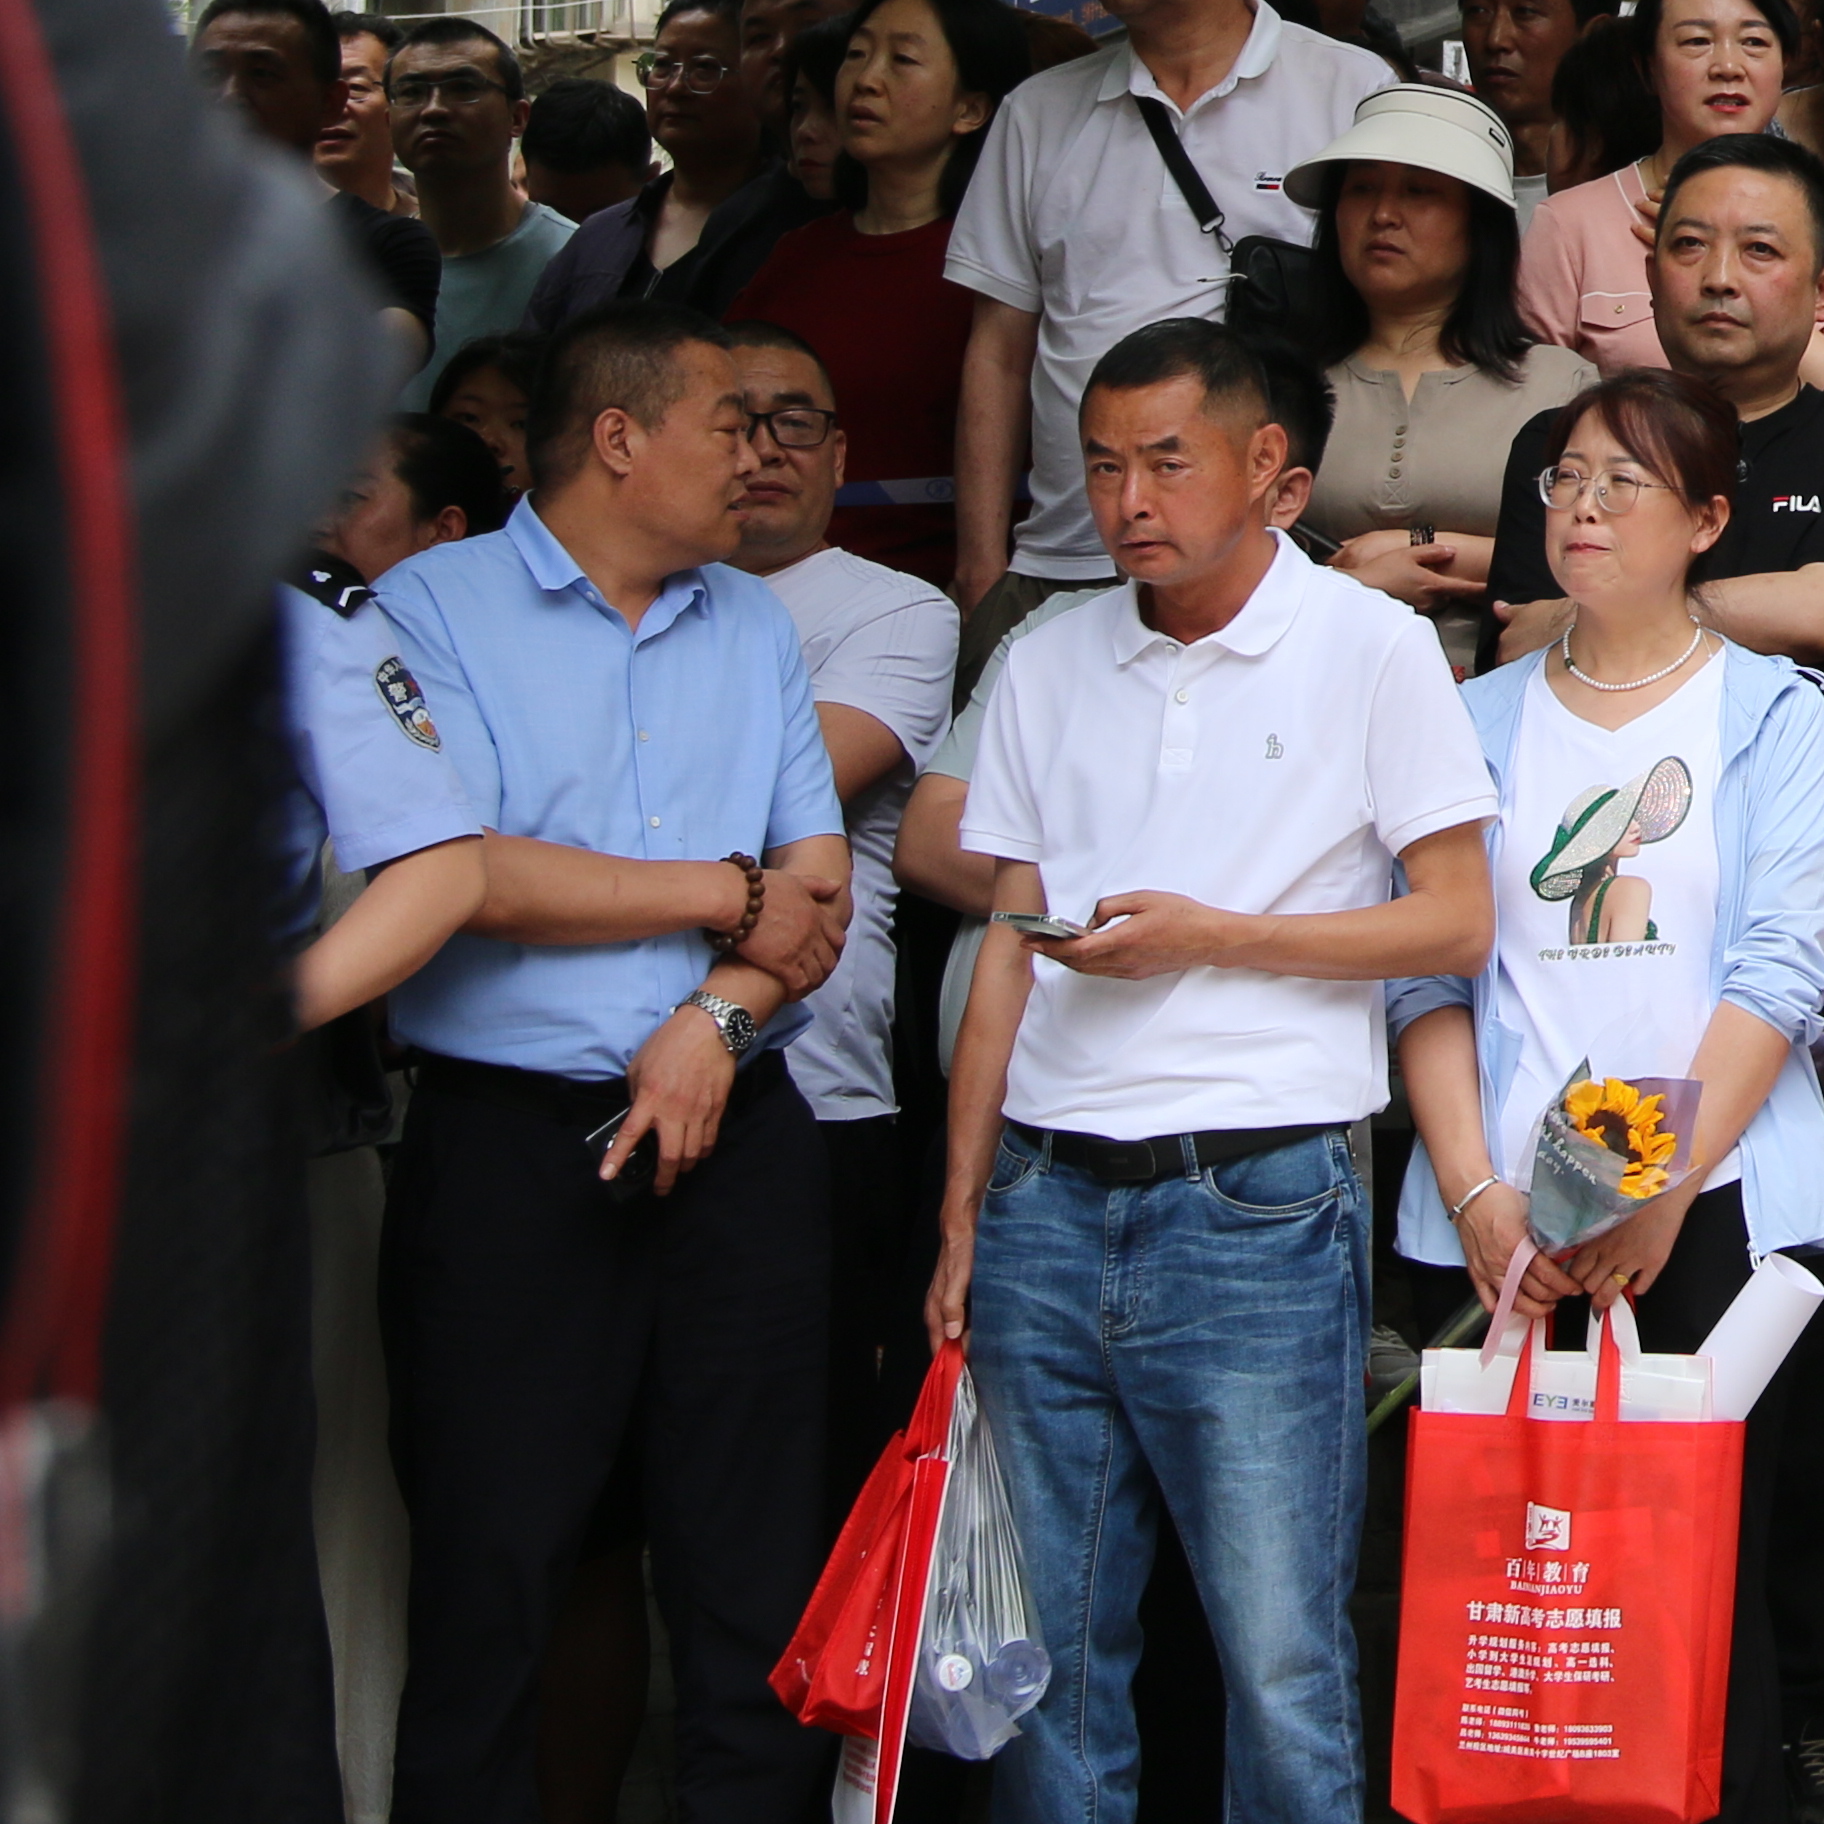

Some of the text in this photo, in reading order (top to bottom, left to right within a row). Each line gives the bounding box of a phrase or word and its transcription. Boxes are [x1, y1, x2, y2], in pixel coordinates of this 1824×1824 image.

[1772, 494, 1822, 513] FILA
[1466, 1600, 1623, 1629] 甘肃新高考志愿填报
